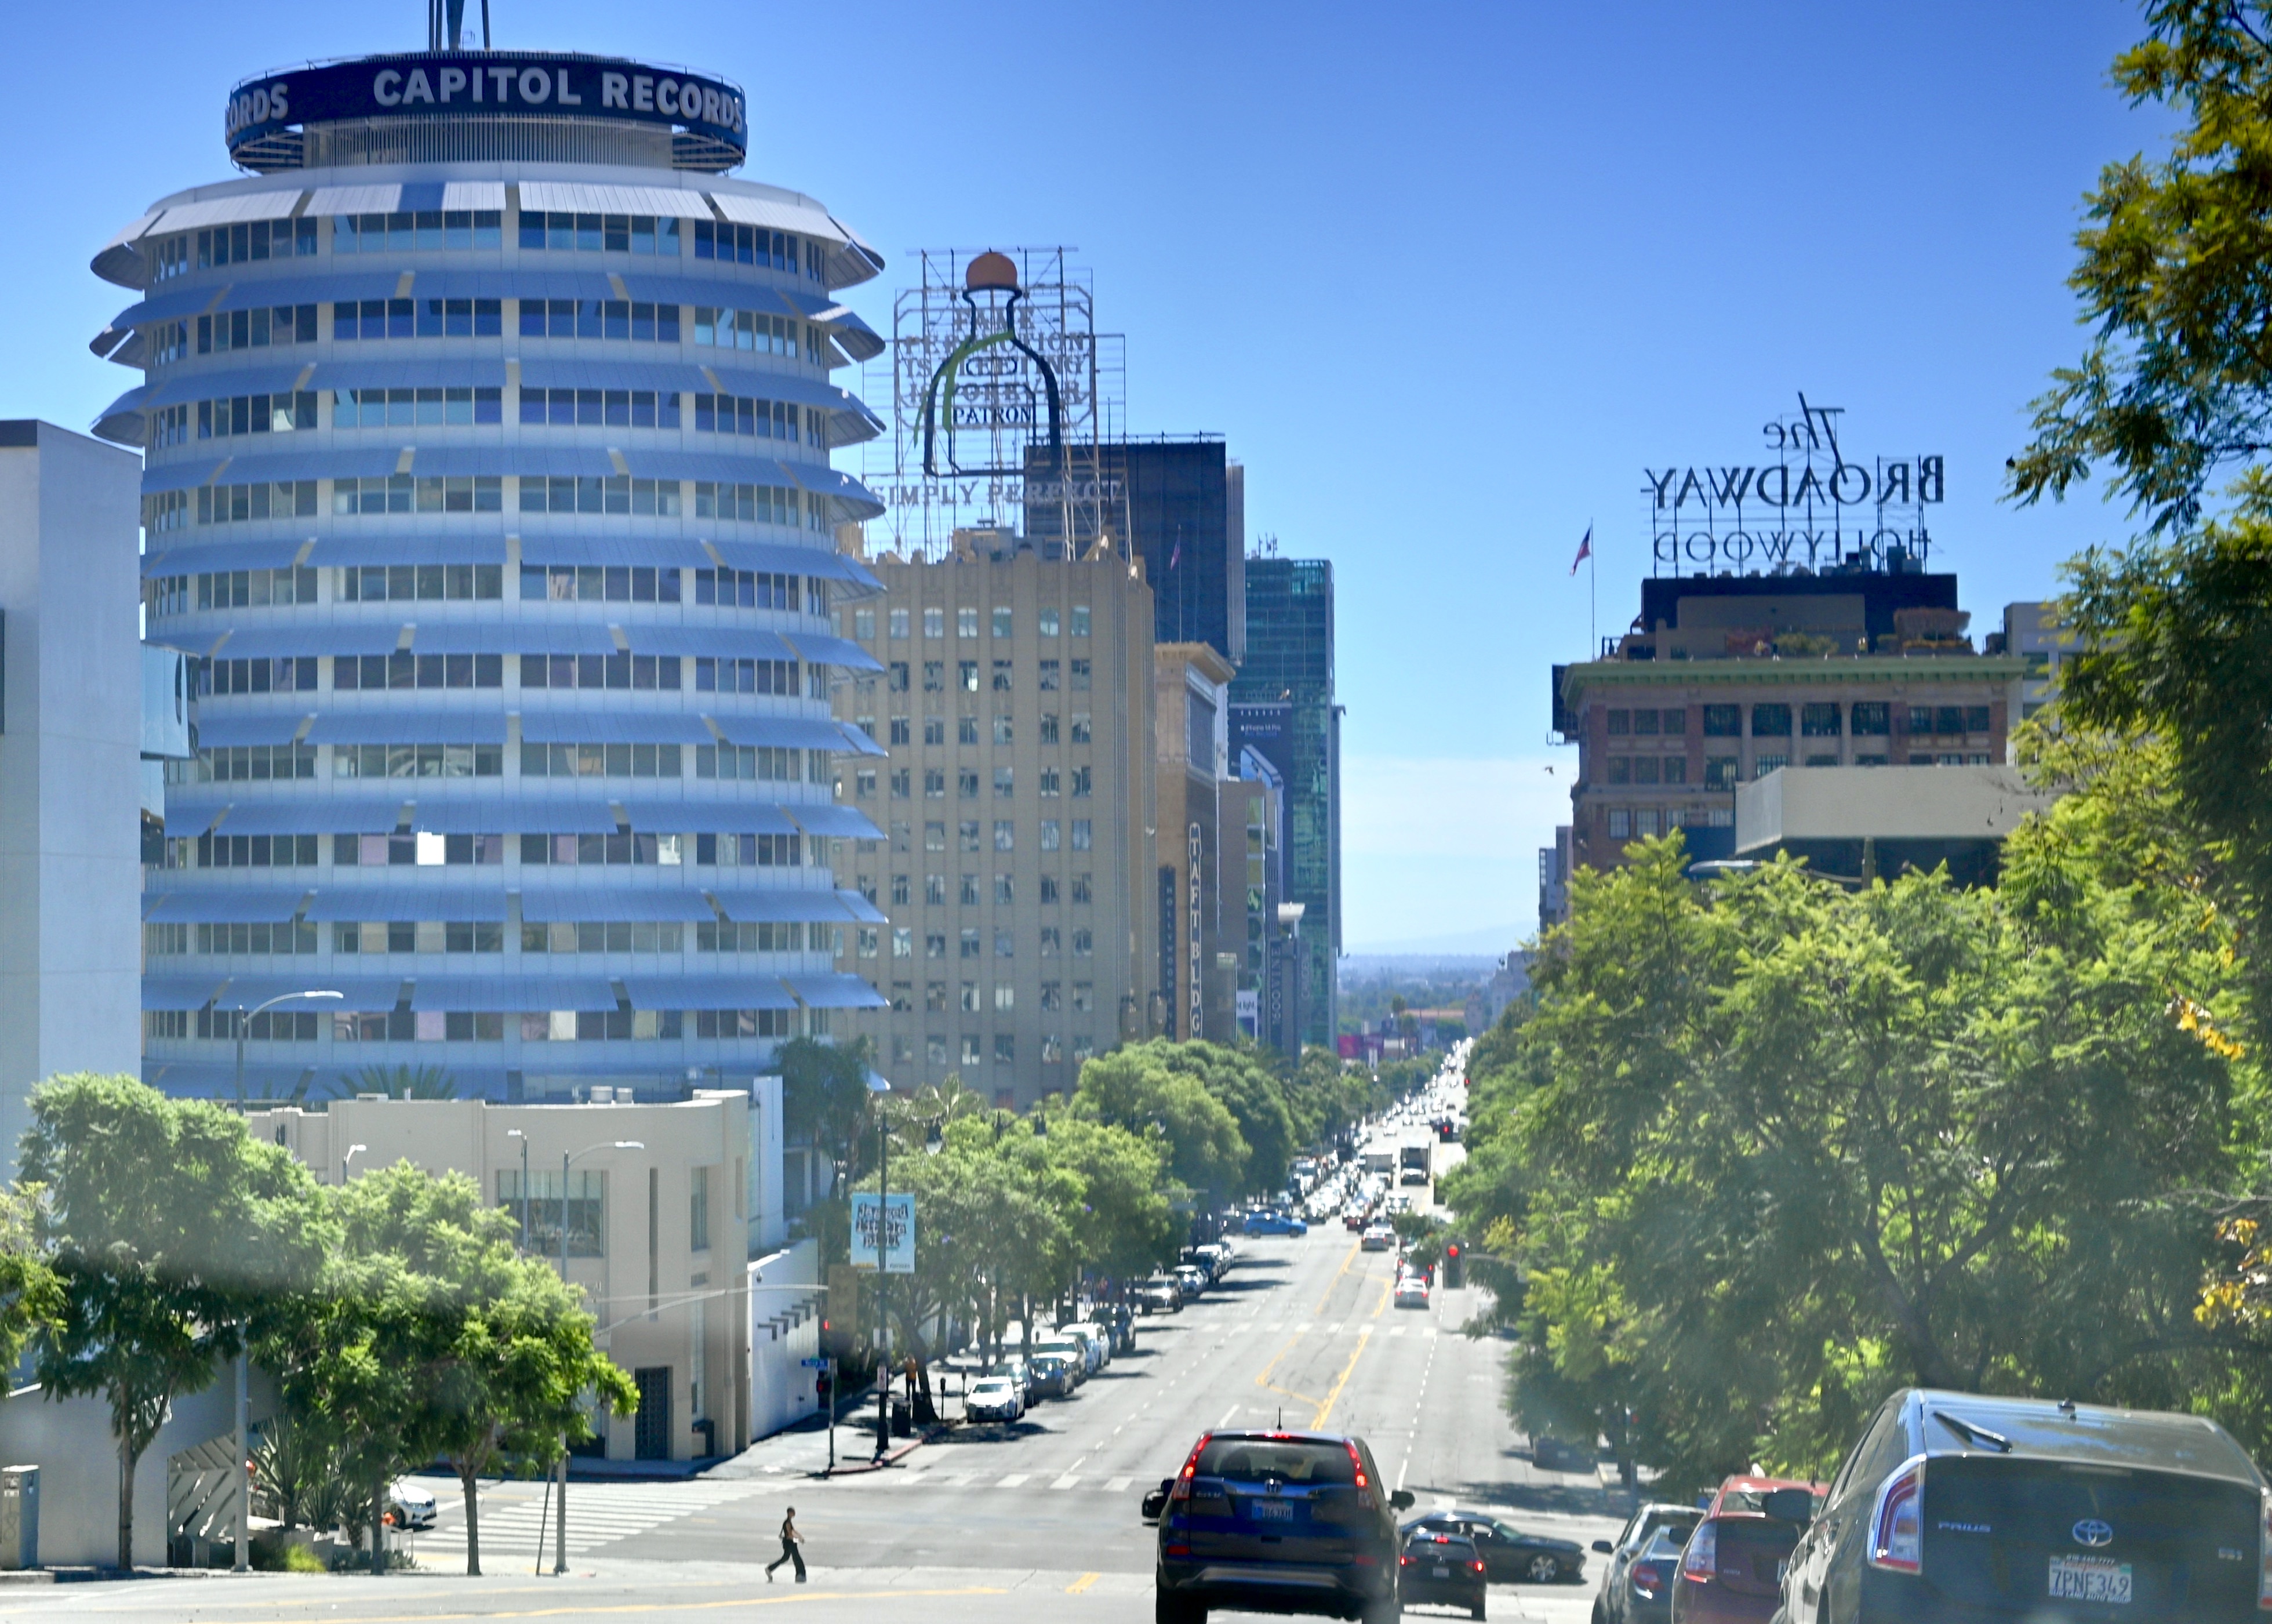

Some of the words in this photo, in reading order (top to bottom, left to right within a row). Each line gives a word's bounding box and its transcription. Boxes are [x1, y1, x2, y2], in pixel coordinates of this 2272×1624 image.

[226, 82, 288, 132] ORDS
[373, 66, 581, 105] CAPITOL
[601, 71, 744, 133] RECORDS
[870, 480, 978, 507] SIMPLY
[987, 481, 1121, 506] PERFECT
[1190, 837, 1199, 928] TAFT
[1191, 941, 1200, 1032] BLDG
[1938, 1521, 1991, 1533] PRIUS
[2051, 1569, 2129, 1596] 7PNF349
